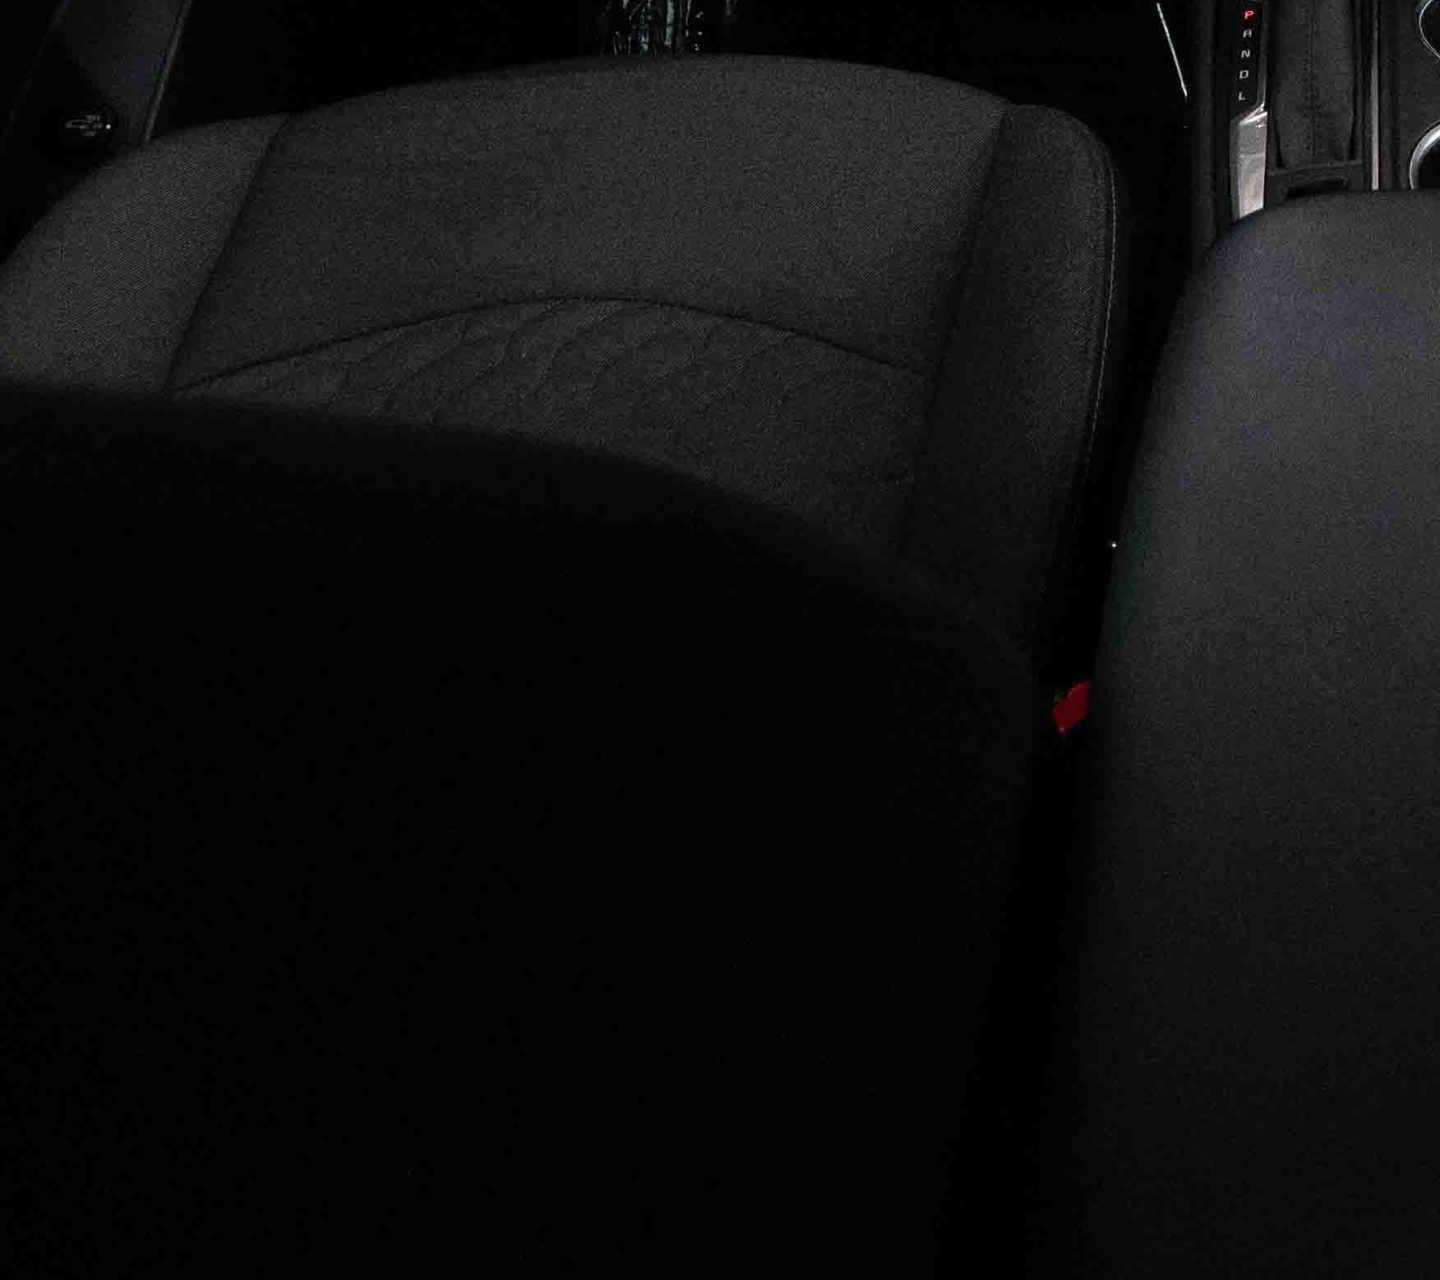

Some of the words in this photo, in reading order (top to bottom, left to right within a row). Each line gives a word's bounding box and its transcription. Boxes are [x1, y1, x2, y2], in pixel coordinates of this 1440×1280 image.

[1244, 10, 1255, 20] P
[1241, 50, 1251, 58] N
[1239, 70, 1249, 79] D
[1237, 91, 1246, 101] L
